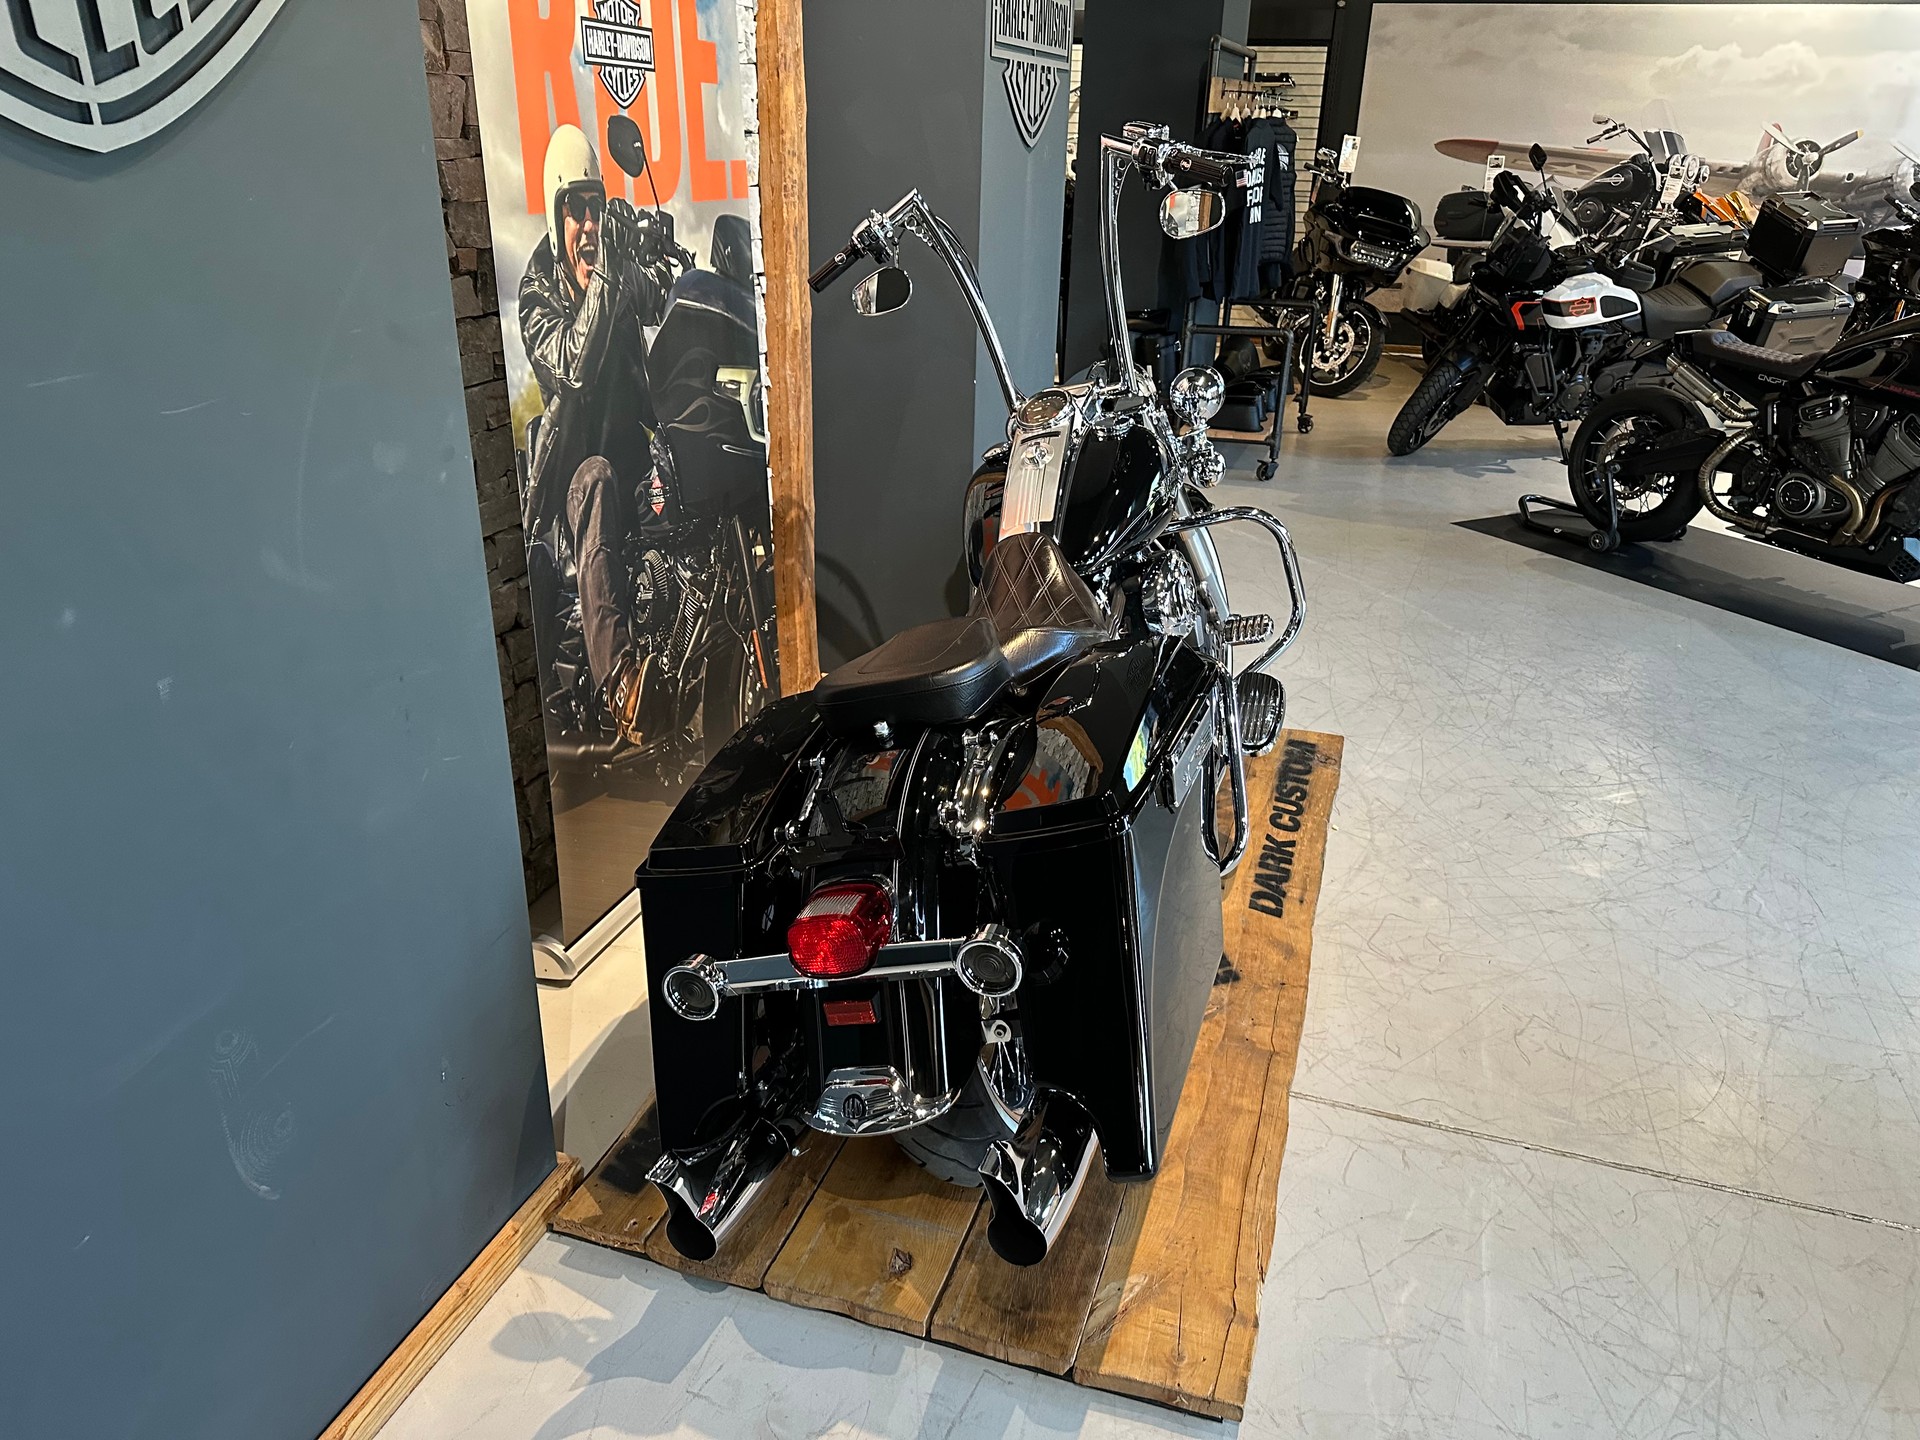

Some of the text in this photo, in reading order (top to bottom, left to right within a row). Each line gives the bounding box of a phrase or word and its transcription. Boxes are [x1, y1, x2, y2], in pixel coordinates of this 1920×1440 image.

[599, 0, 636, 27] MOTOR
[586, 27, 652, 63] HARLEY-DAVIDSON
[604, 65, 640, 101] CYCLES
[1015, 60, 1052, 127] CYCLES
[1248, 738, 1317, 918] DARK CUSTOM
